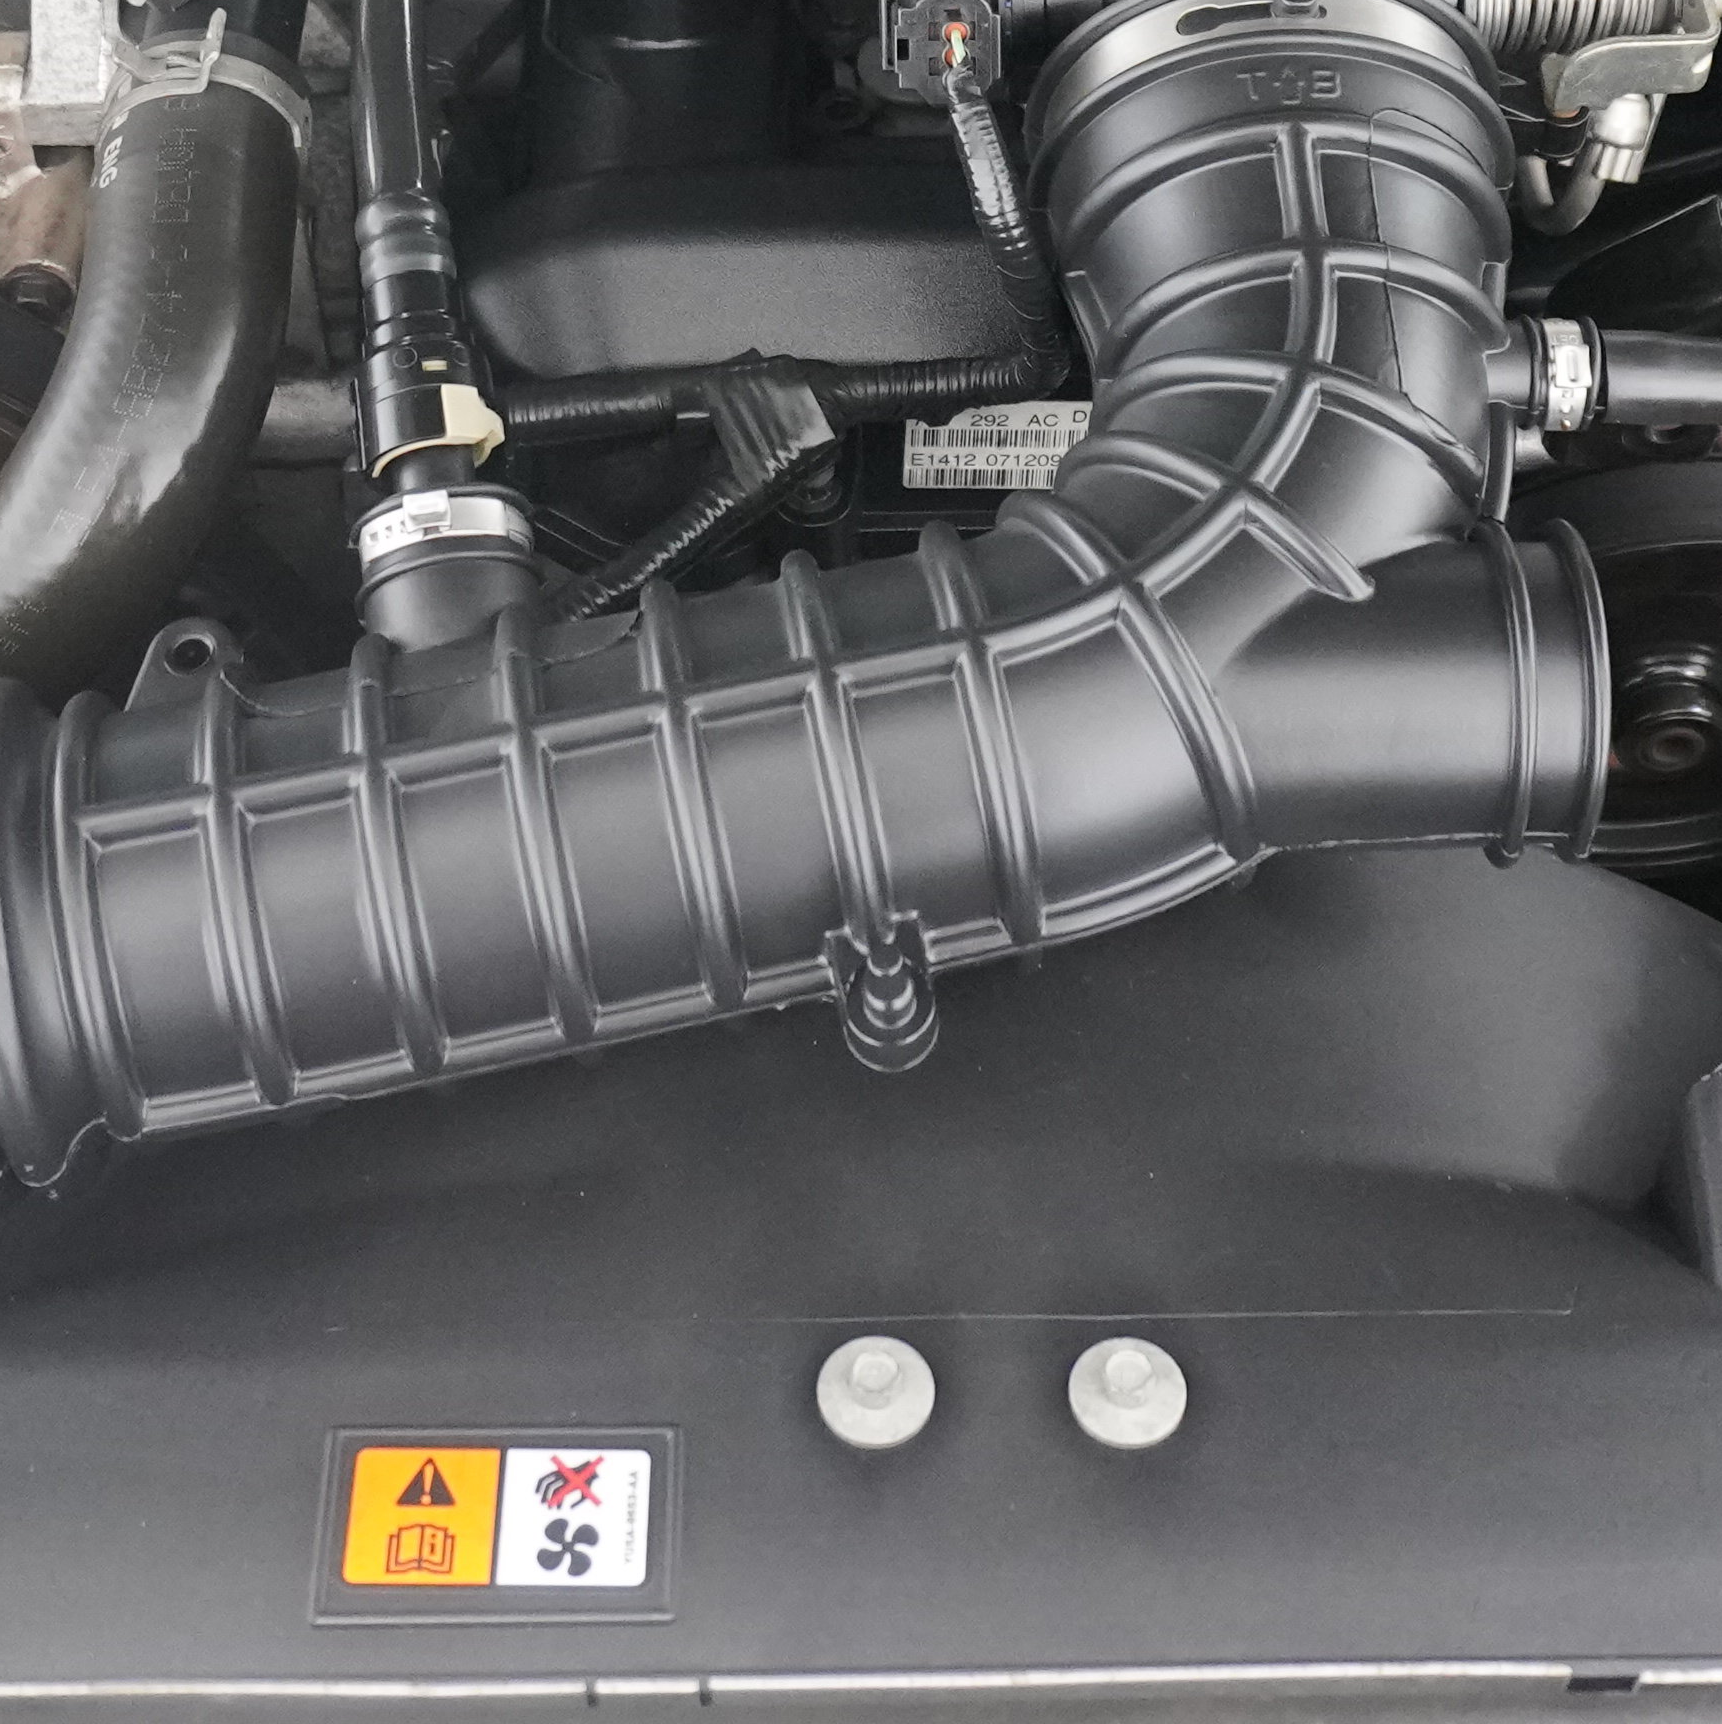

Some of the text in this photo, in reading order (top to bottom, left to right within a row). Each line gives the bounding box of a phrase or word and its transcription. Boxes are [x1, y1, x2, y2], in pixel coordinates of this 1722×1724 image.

[98, 135, 124, 189] ENG
[970, 410, 1088, 427] 292 AC D
[911, 453, 1062, 467] E1412 071209
